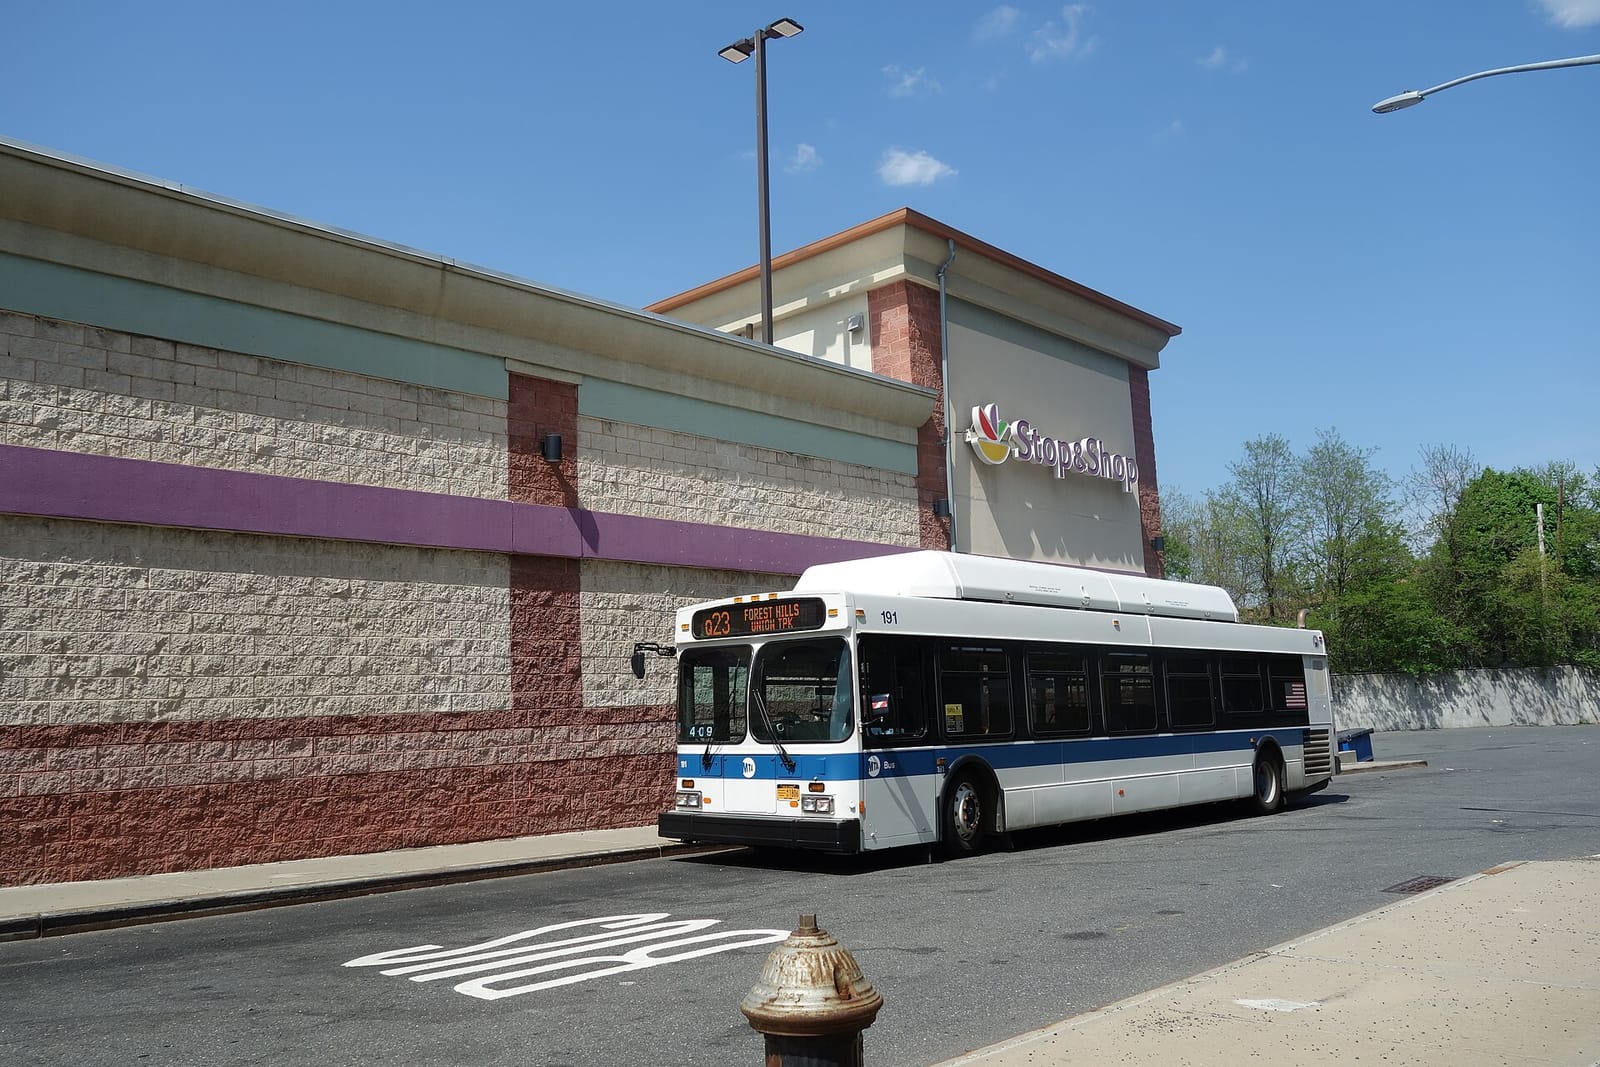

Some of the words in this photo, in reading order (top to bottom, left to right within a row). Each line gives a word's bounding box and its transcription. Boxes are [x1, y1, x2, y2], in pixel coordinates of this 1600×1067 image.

[744, 606, 773, 621] FOREST
[775, 603, 800, 618] HILLS
[881, 610, 898, 625] 191
[704, 611, 731, 636] Q23
[751, 619, 775, 632] UNION
[778, 617, 793, 629] TPK
[689, 726, 713, 737] 409
[742, 760, 755, 775] MTA
[883, 761, 896, 770] Bus
[341, 913, 792, 1000] BUS
